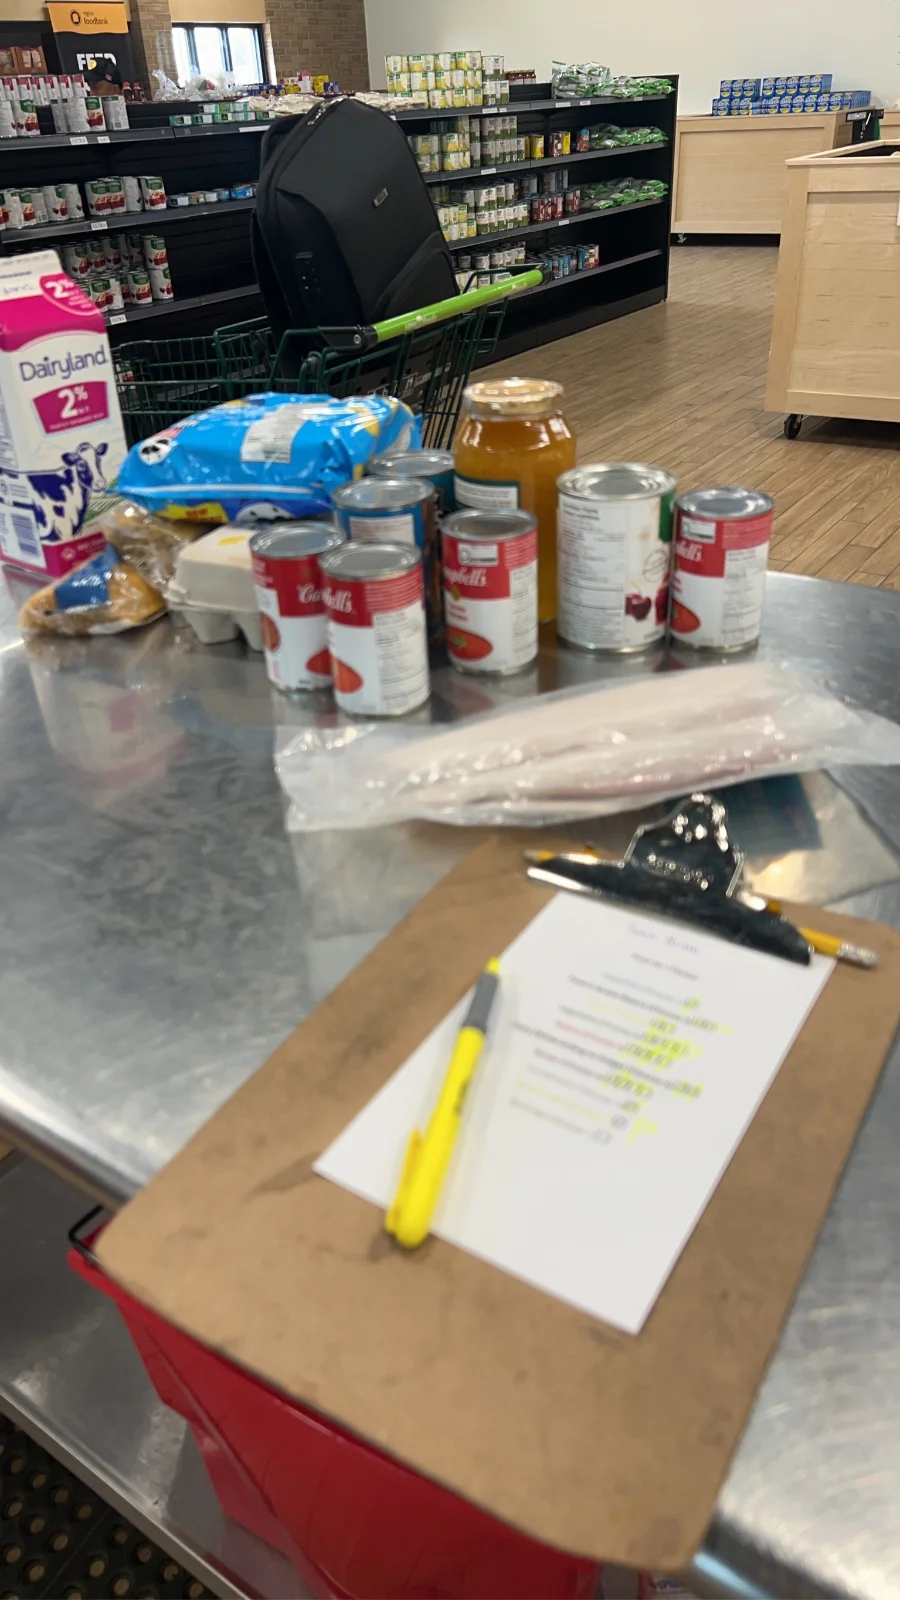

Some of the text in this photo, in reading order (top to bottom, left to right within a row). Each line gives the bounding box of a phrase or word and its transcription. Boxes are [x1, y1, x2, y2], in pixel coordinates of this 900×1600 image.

[84, 17, 109, 25] foodbank
[45, 278, 75, 299] 2%
[19, 344, 107, 382] Dairyland
[57, 384, 89, 420] 2%
